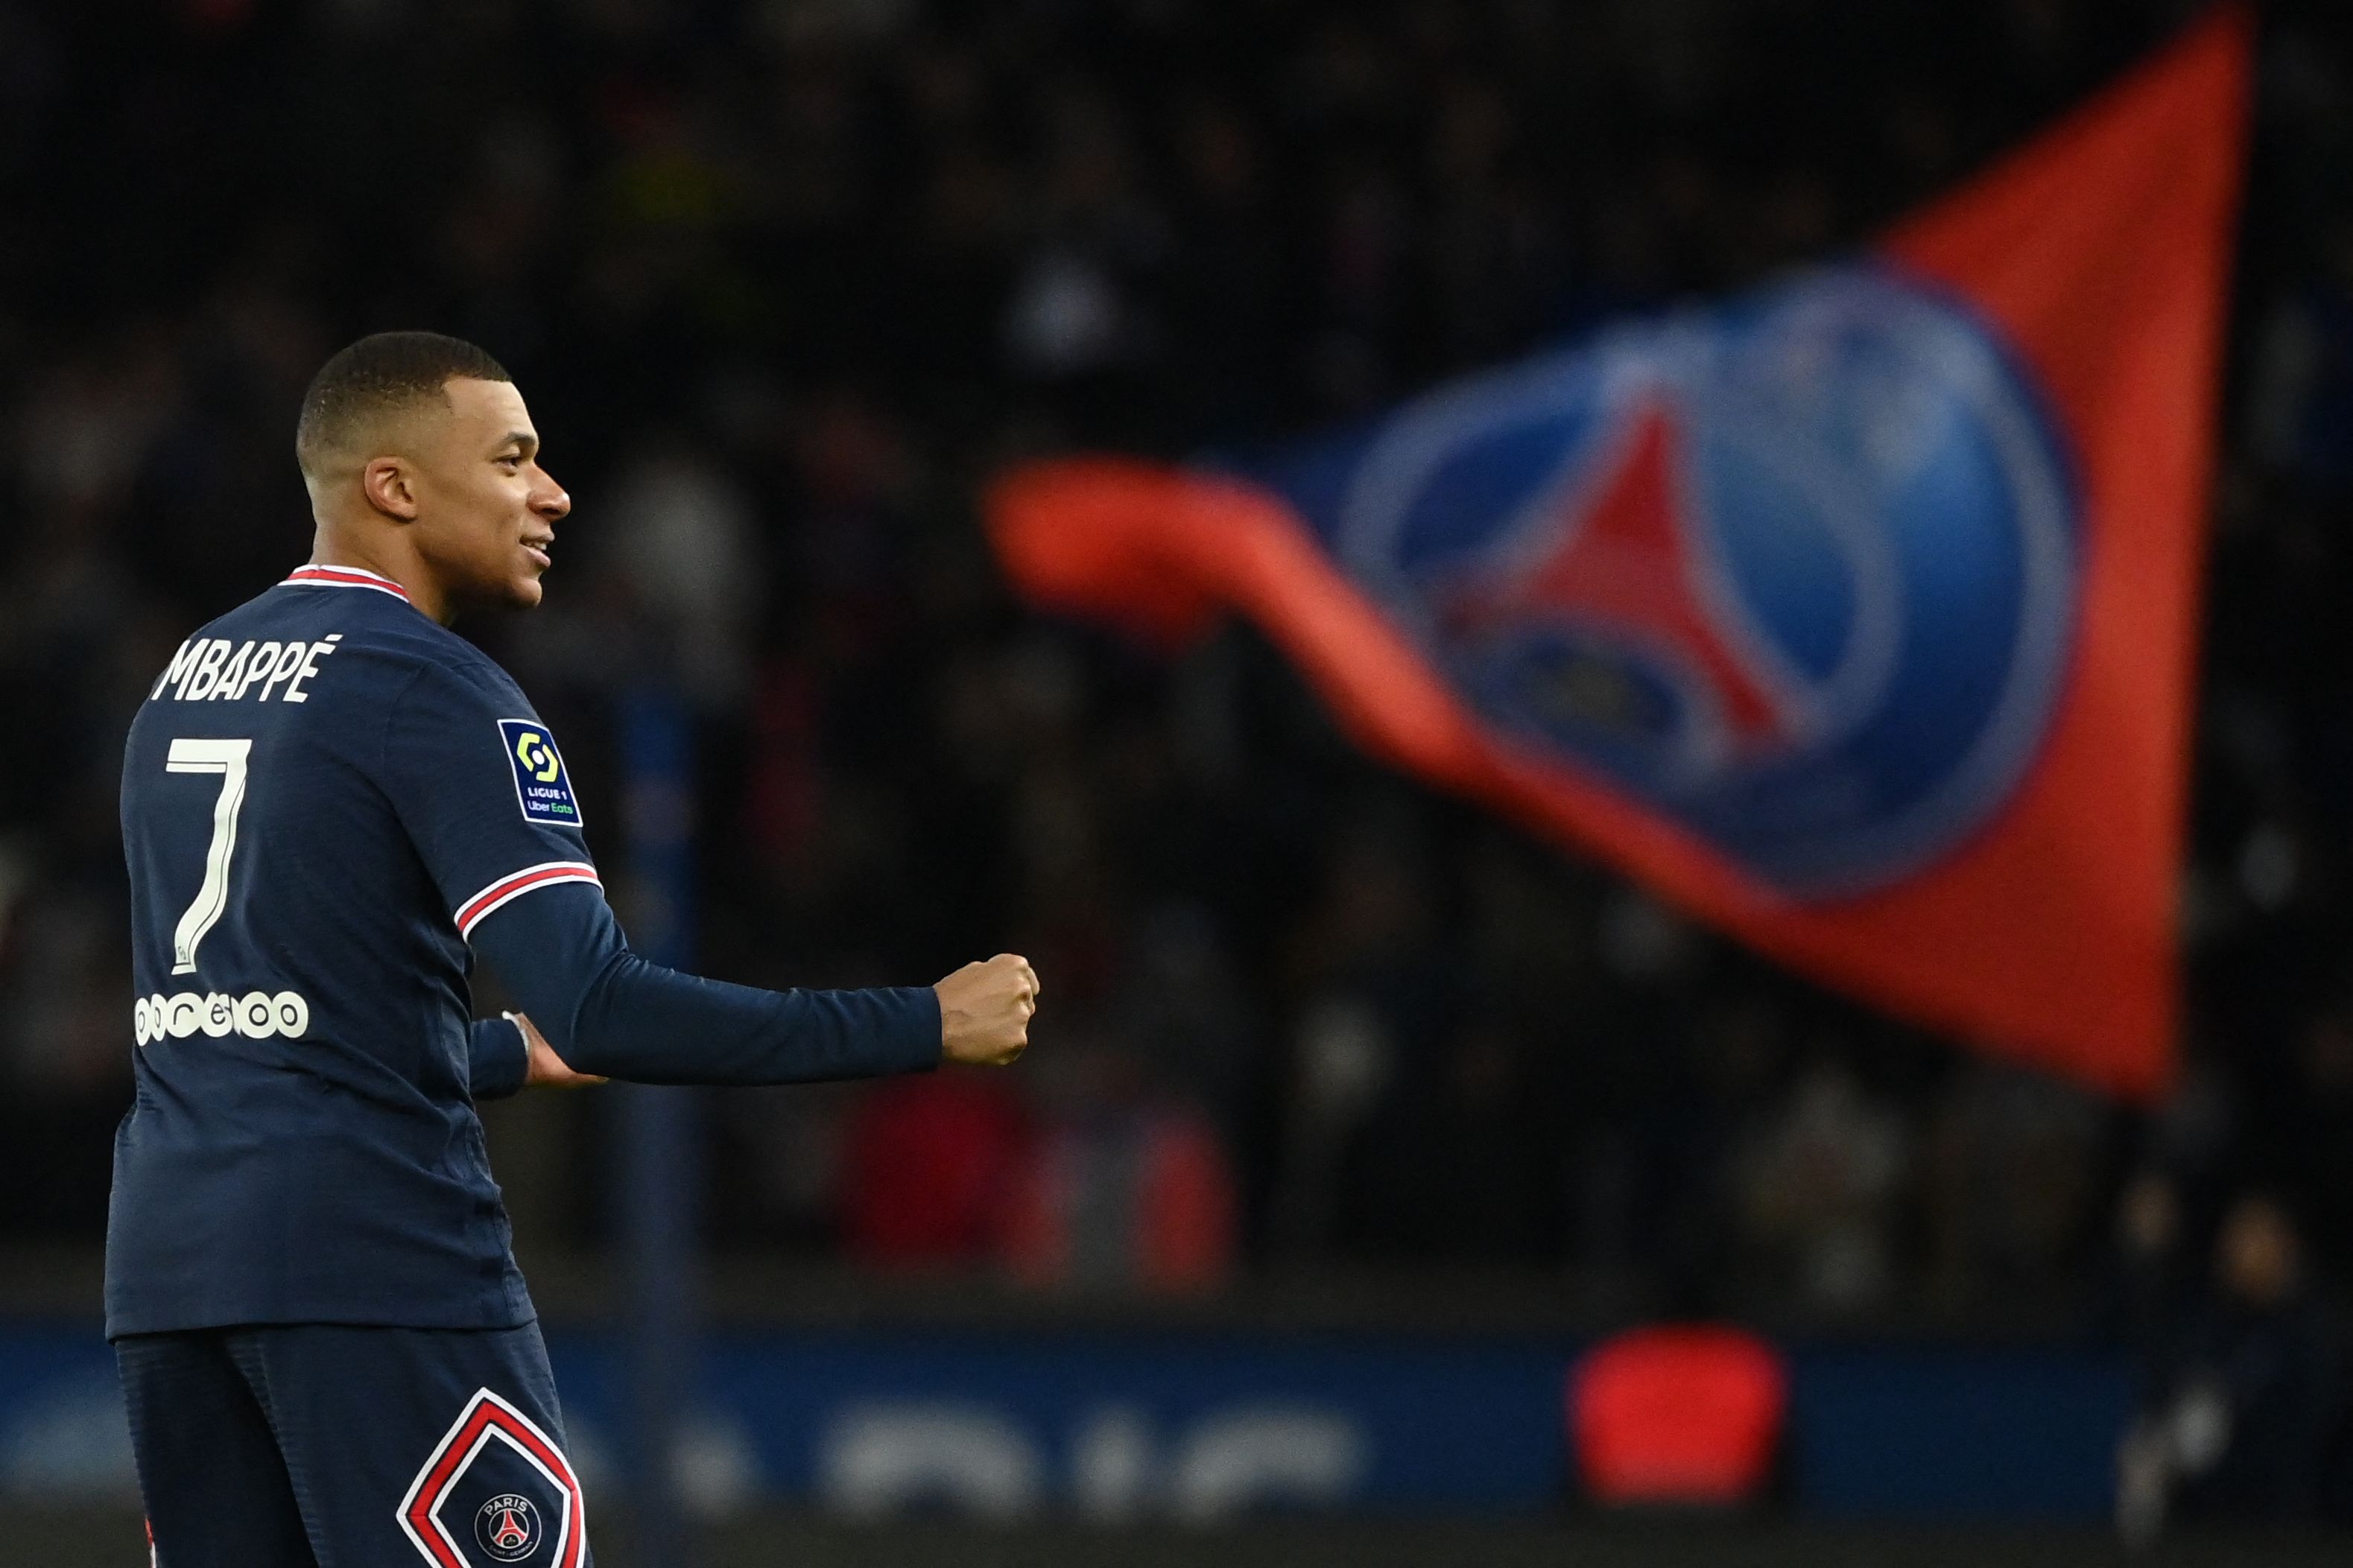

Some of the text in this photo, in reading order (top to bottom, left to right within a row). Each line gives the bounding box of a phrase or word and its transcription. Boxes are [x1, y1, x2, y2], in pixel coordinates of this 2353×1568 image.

[151, 634, 343, 702] MBAPPÉ
[528, 787, 567, 800] LIGUE 1
[528, 800, 573, 814] Uber Eats
[165, 738, 252, 975] 7
[136, 994, 305, 1044] ooreoo
[484, 1497, 528, 1516] PARIS
